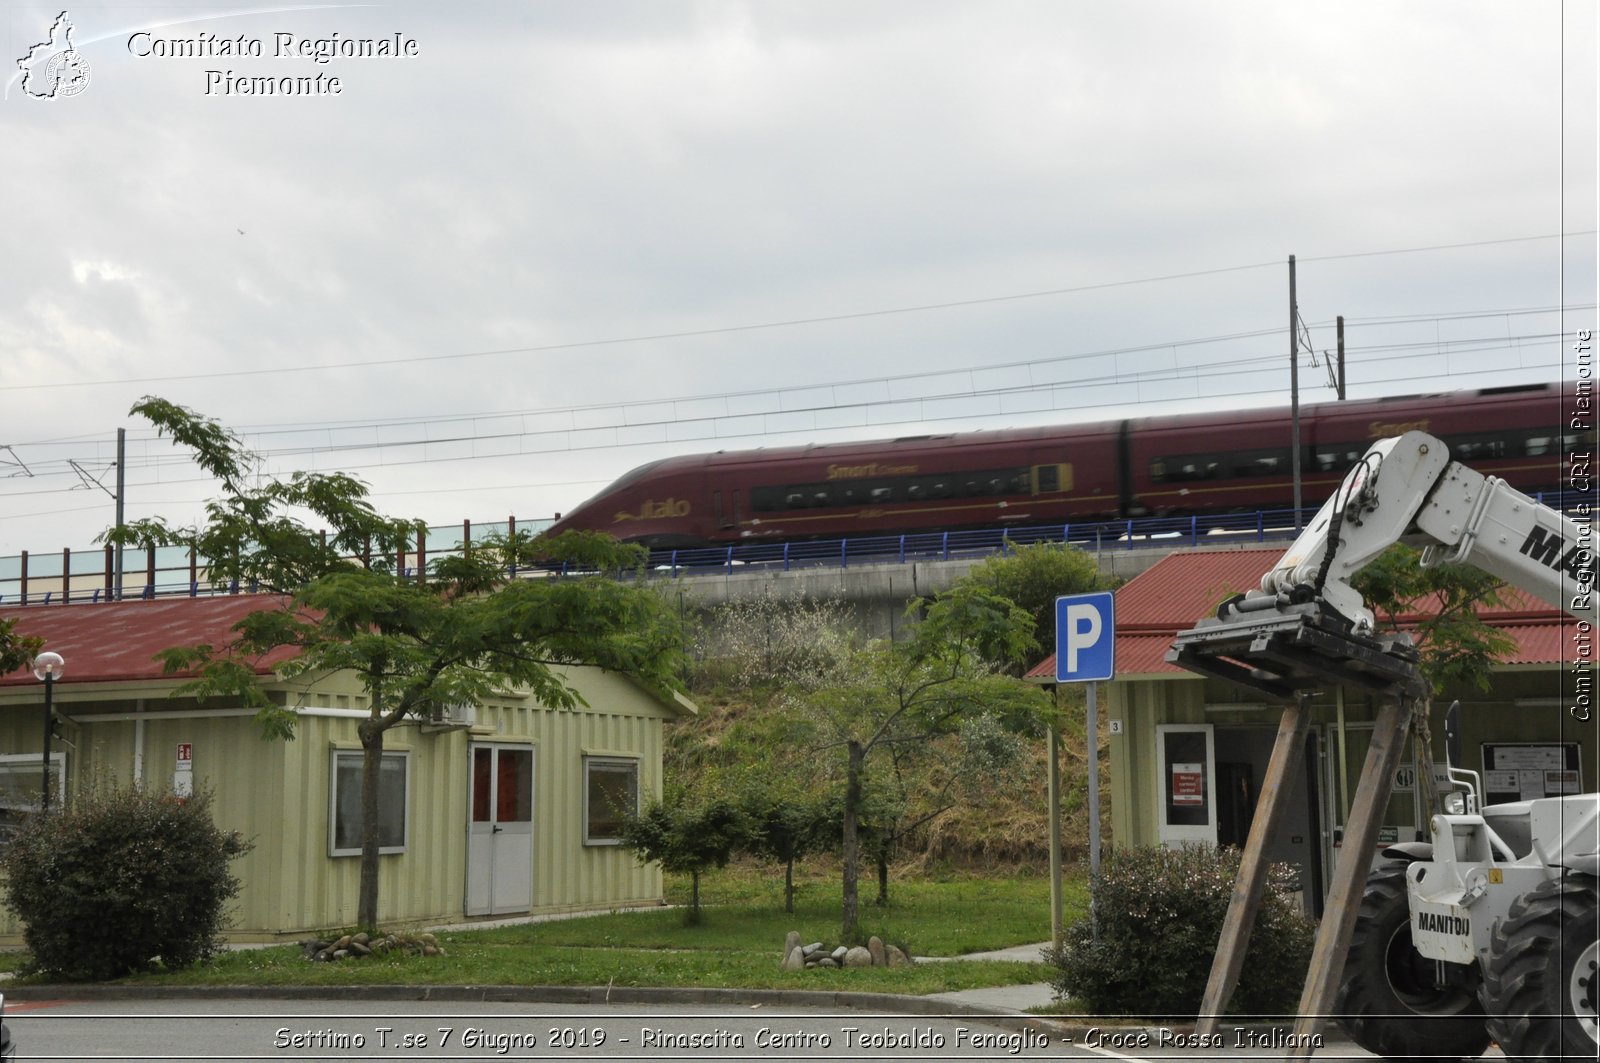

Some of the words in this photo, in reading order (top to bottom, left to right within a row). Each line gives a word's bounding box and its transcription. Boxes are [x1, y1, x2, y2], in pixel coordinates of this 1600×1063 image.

[826, 463, 878, 480] Smart
[1067, 603, 1102, 673] P
[1113, 722, 1119, 732] 3
[1418, 911, 1470, 937] MANITOU
